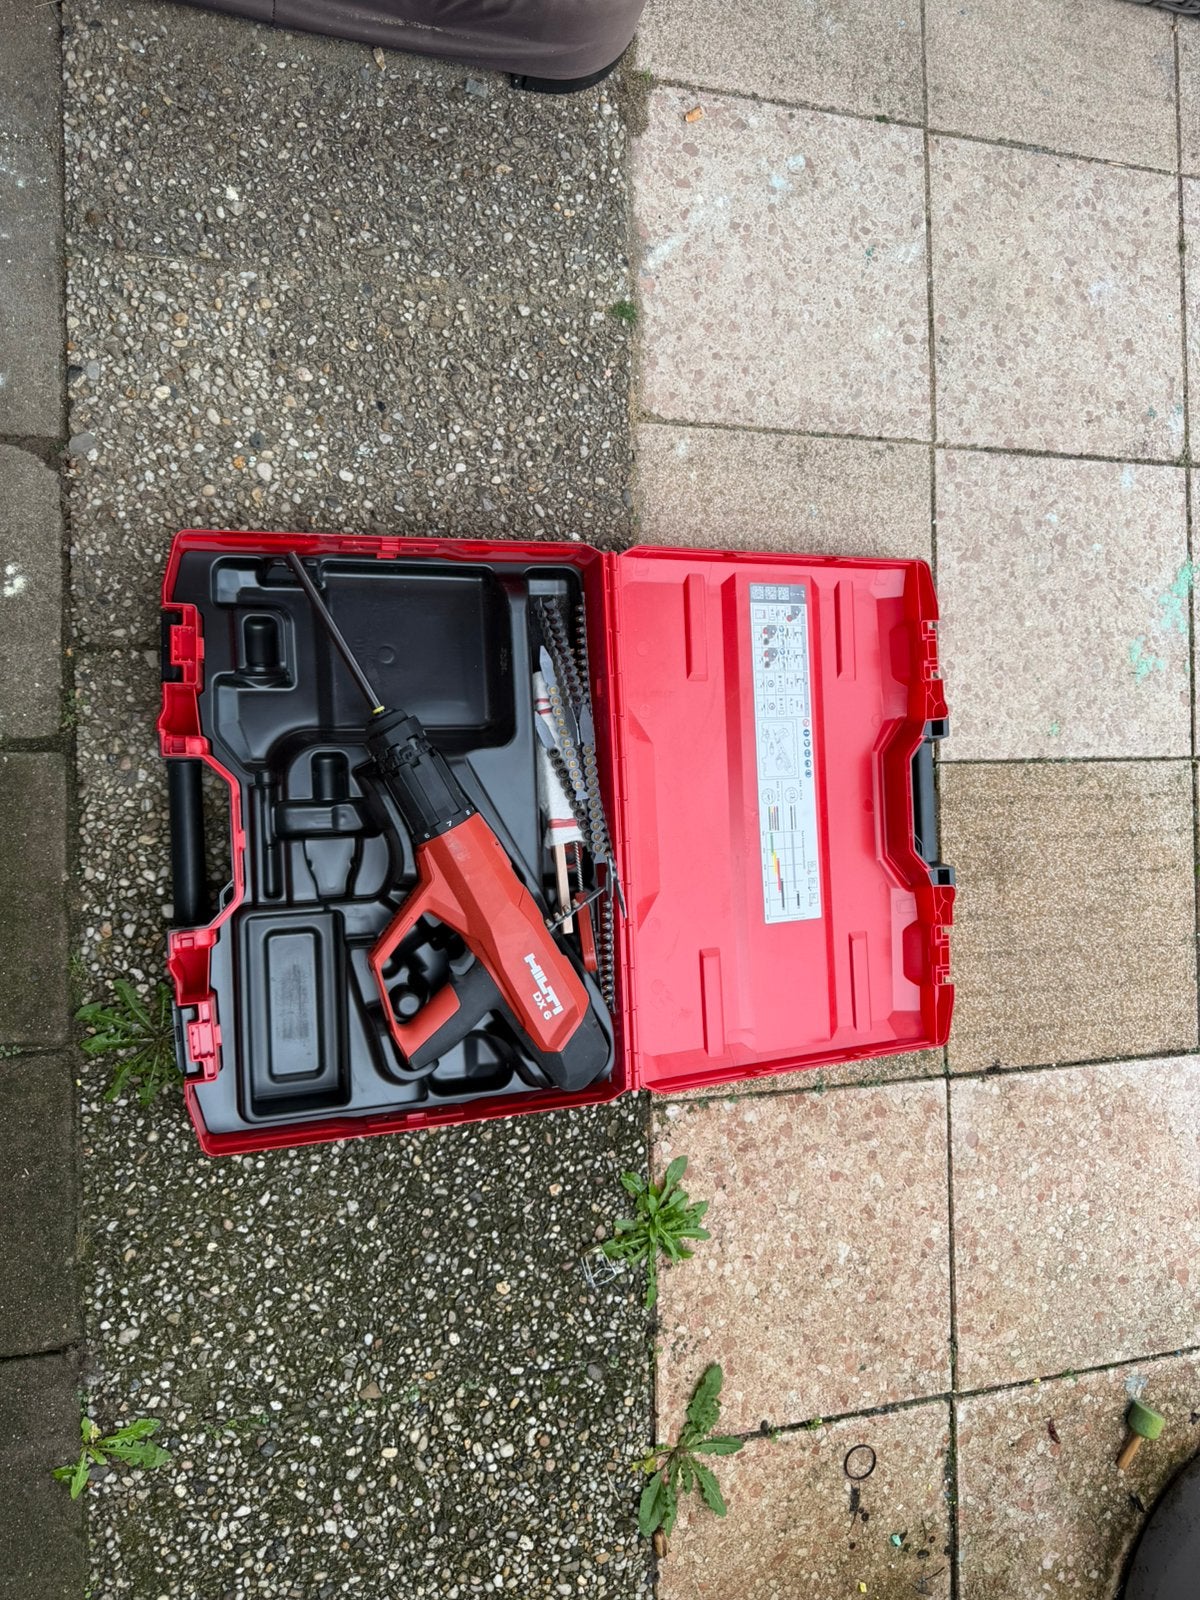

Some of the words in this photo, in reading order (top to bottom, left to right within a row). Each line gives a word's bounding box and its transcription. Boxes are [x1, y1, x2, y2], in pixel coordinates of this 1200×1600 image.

[524, 953, 564, 1016] HILTI
[532, 991, 548, 1010] DX
[543, 1010, 552, 1020] 6
